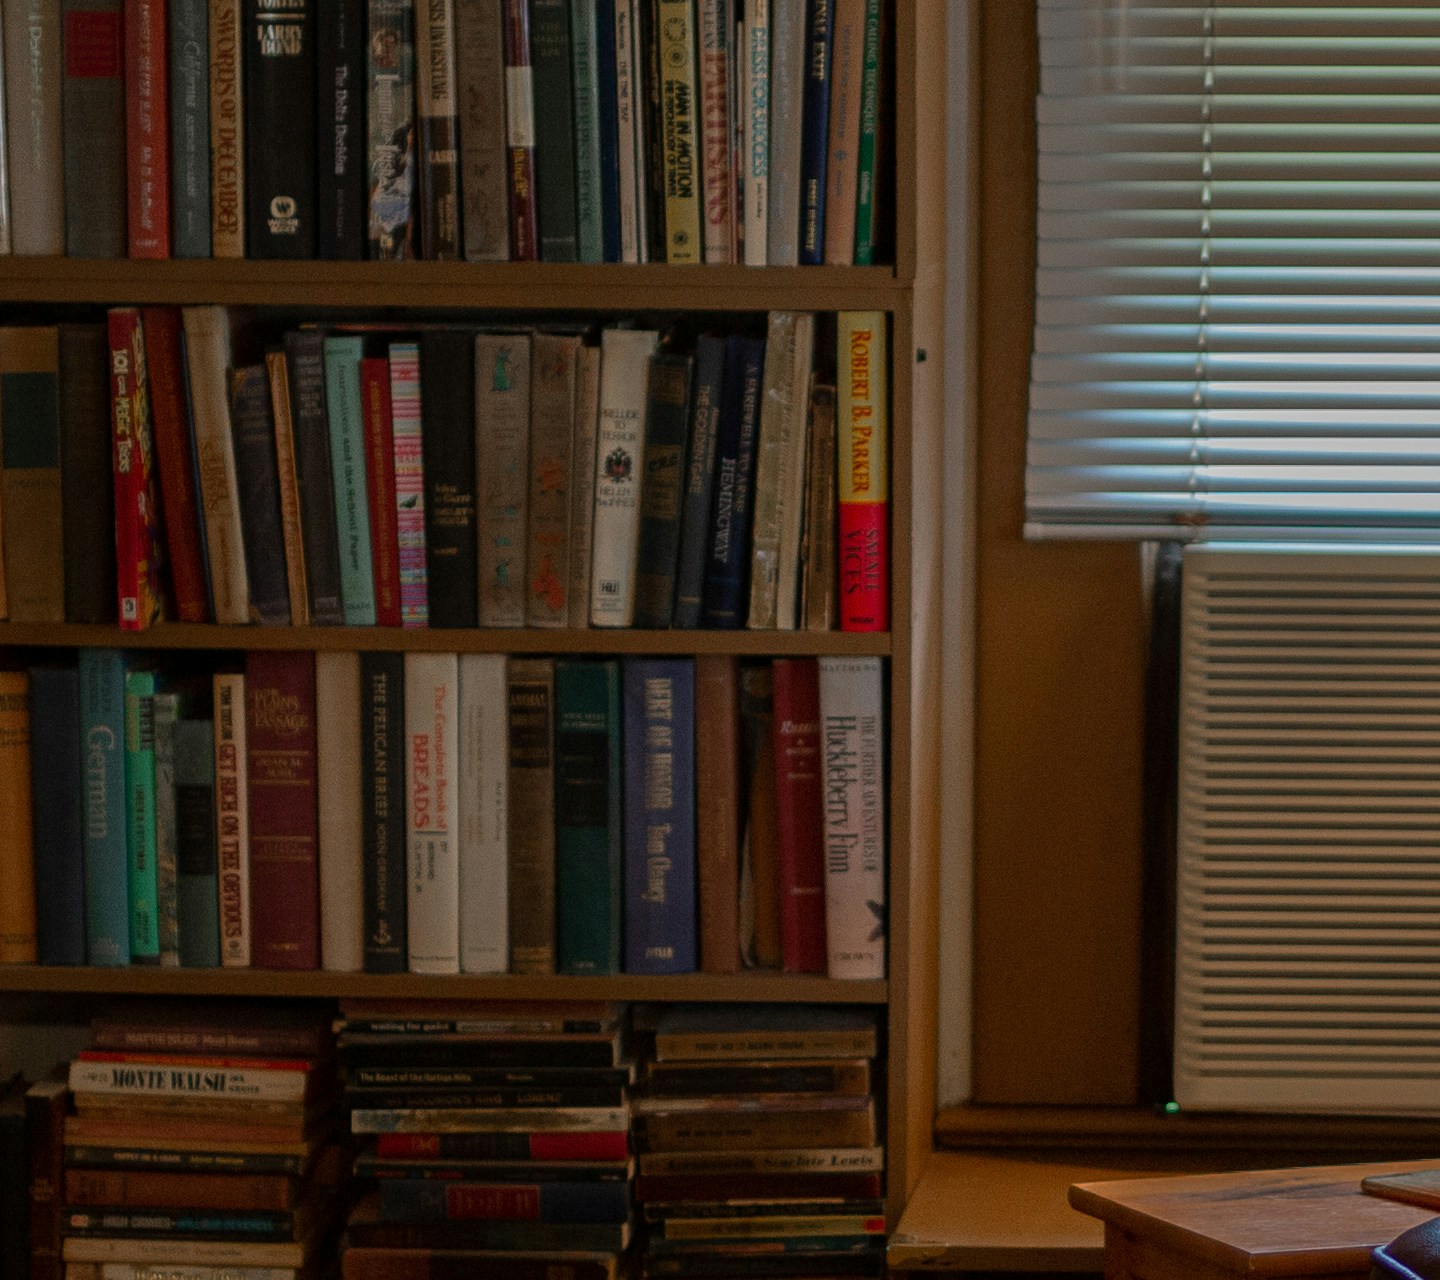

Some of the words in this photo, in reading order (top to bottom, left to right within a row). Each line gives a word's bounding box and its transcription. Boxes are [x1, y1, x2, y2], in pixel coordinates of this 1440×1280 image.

[851, 329, 872, 387] ROBERT
[852, 395, 872, 413] B.
[851, 418, 873, 495] PARKER
[714, 457, 737, 564] HEMINGWAY
[83, 724, 115, 840] German
[413, 734, 429, 828] BREADS
[824, 716, 857, 828] Huckleberry
[828, 834, 847, 873] Finn
[112, 1068, 169, 1091] MONTE
[173, 1071, 226, 1093] WALSH
